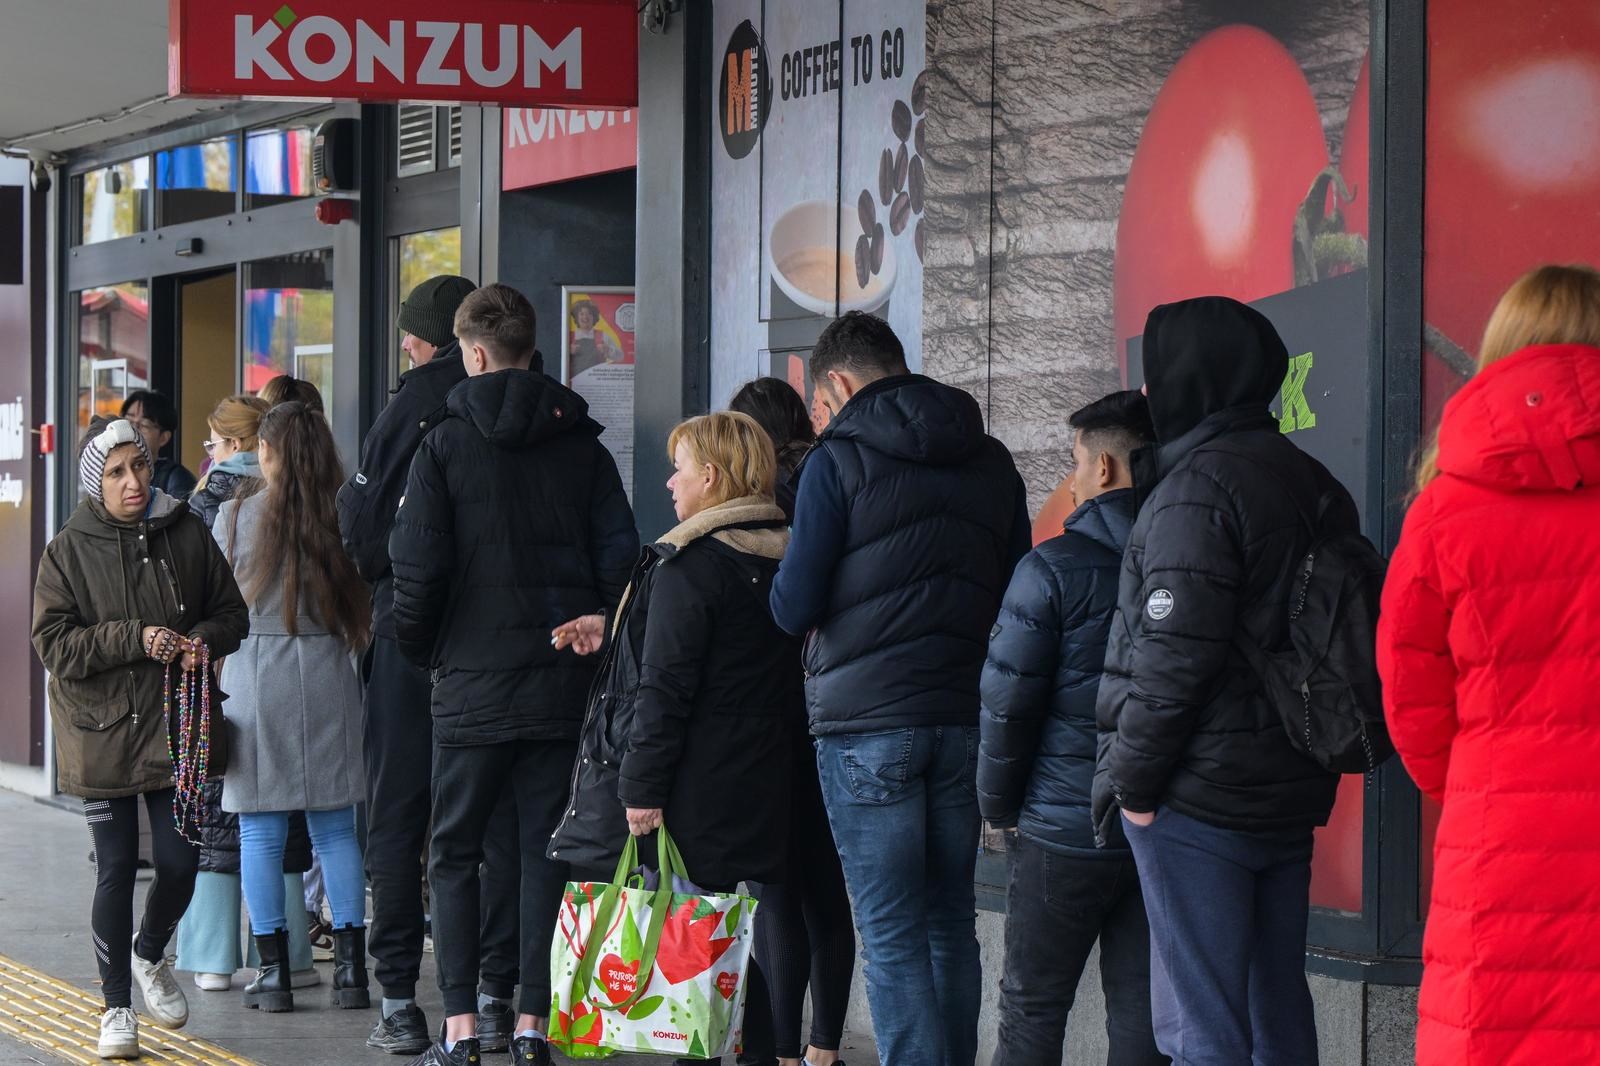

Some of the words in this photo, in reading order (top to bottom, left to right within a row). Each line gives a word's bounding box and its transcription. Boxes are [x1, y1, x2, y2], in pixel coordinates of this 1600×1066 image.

[234, 14, 583, 90] KONZUM
[750, 45, 759, 130] MINUTE
[781, 39, 840, 101] COFFEE
[851, 33, 873, 87] TO
[880, 26, 905, 81] GO
[508, 107, 631, 149] KONZ
[727, 48, 751, 136] M
[652, 1030, 688, 1041] KONZUM
